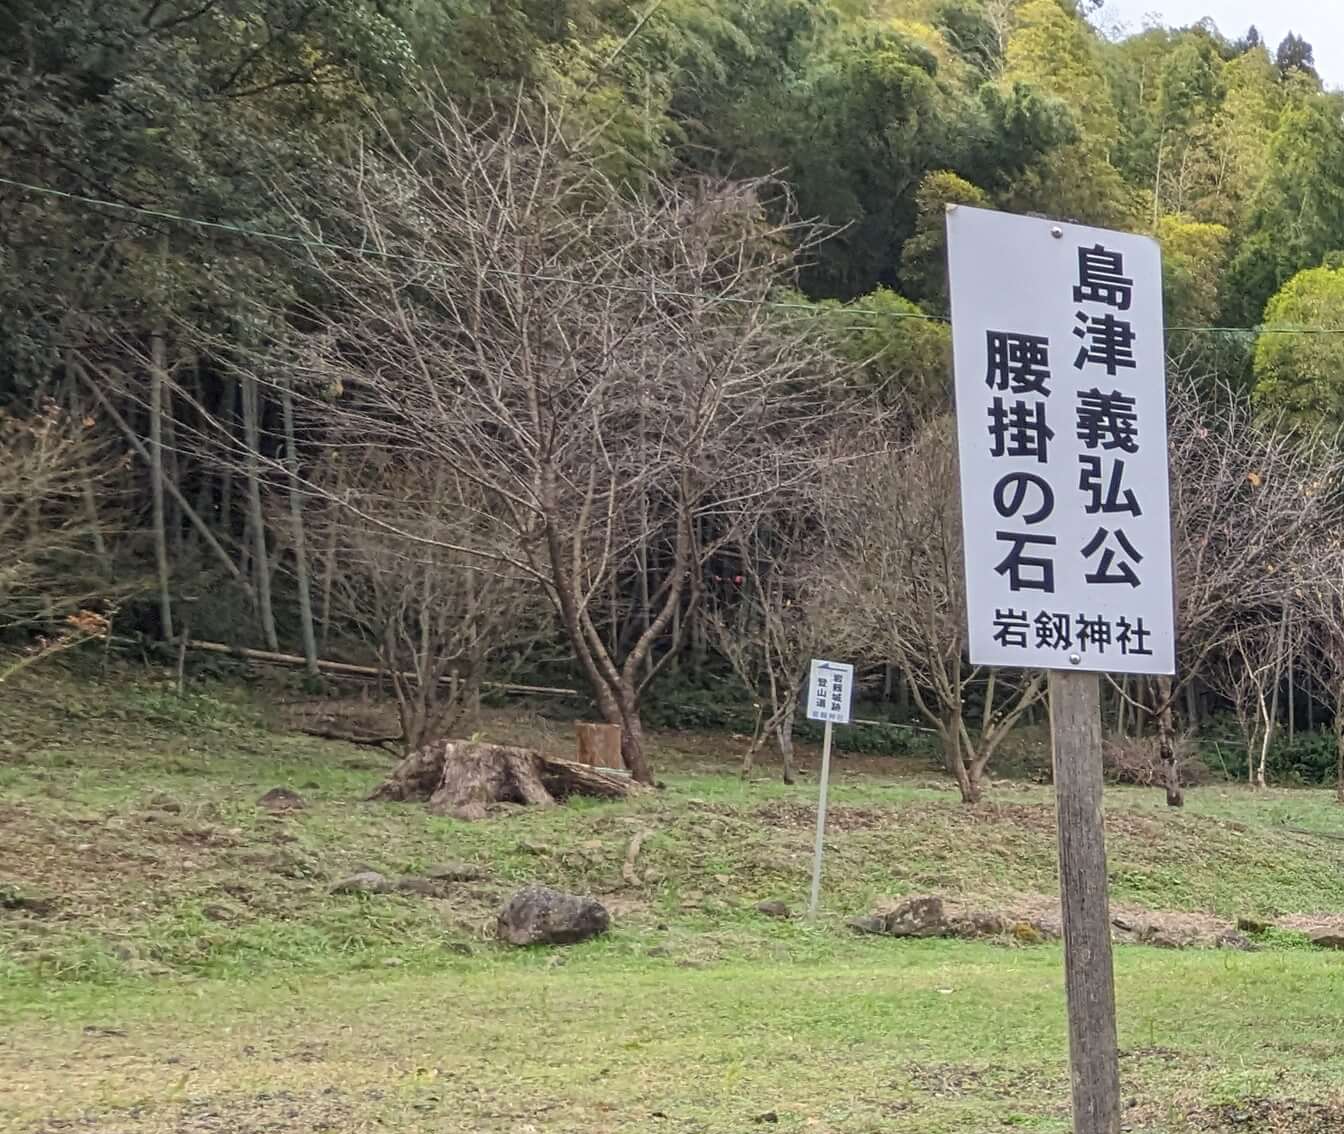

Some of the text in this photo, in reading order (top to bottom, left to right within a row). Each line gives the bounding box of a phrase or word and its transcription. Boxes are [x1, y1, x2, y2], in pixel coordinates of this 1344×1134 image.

[985, 330, 1055, 594] 腰掛の石
[1073, 244, 1143, 588] 島津義弘公
